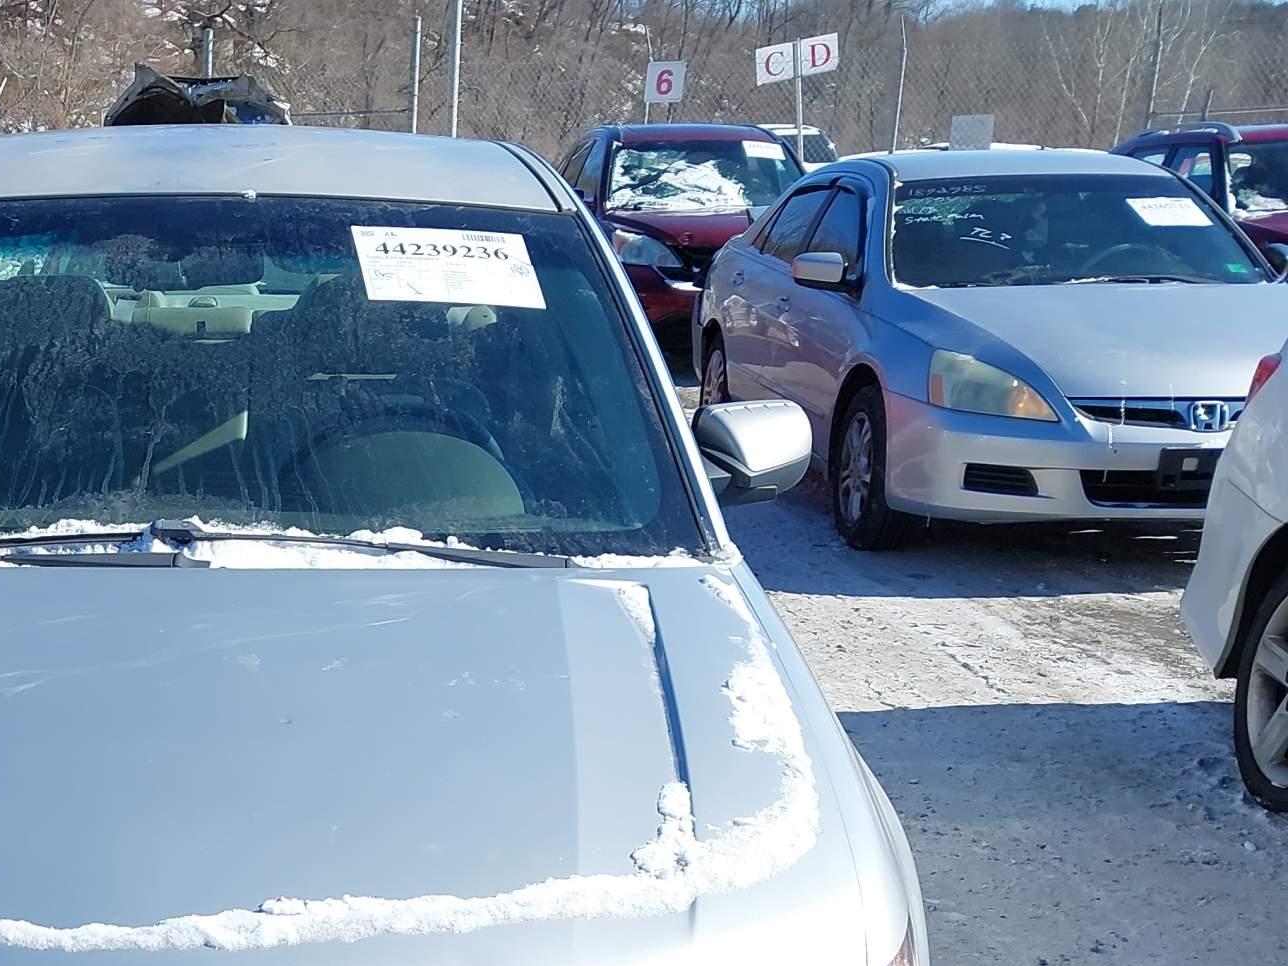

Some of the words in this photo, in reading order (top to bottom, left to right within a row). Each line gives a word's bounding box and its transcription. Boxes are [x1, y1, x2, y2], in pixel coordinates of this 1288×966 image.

[765, 51, 785, 76] C
[808, 42, 831, 69] D
[656, 69, 673, 95] 6
[375, 242, 509, 260] 44239236
